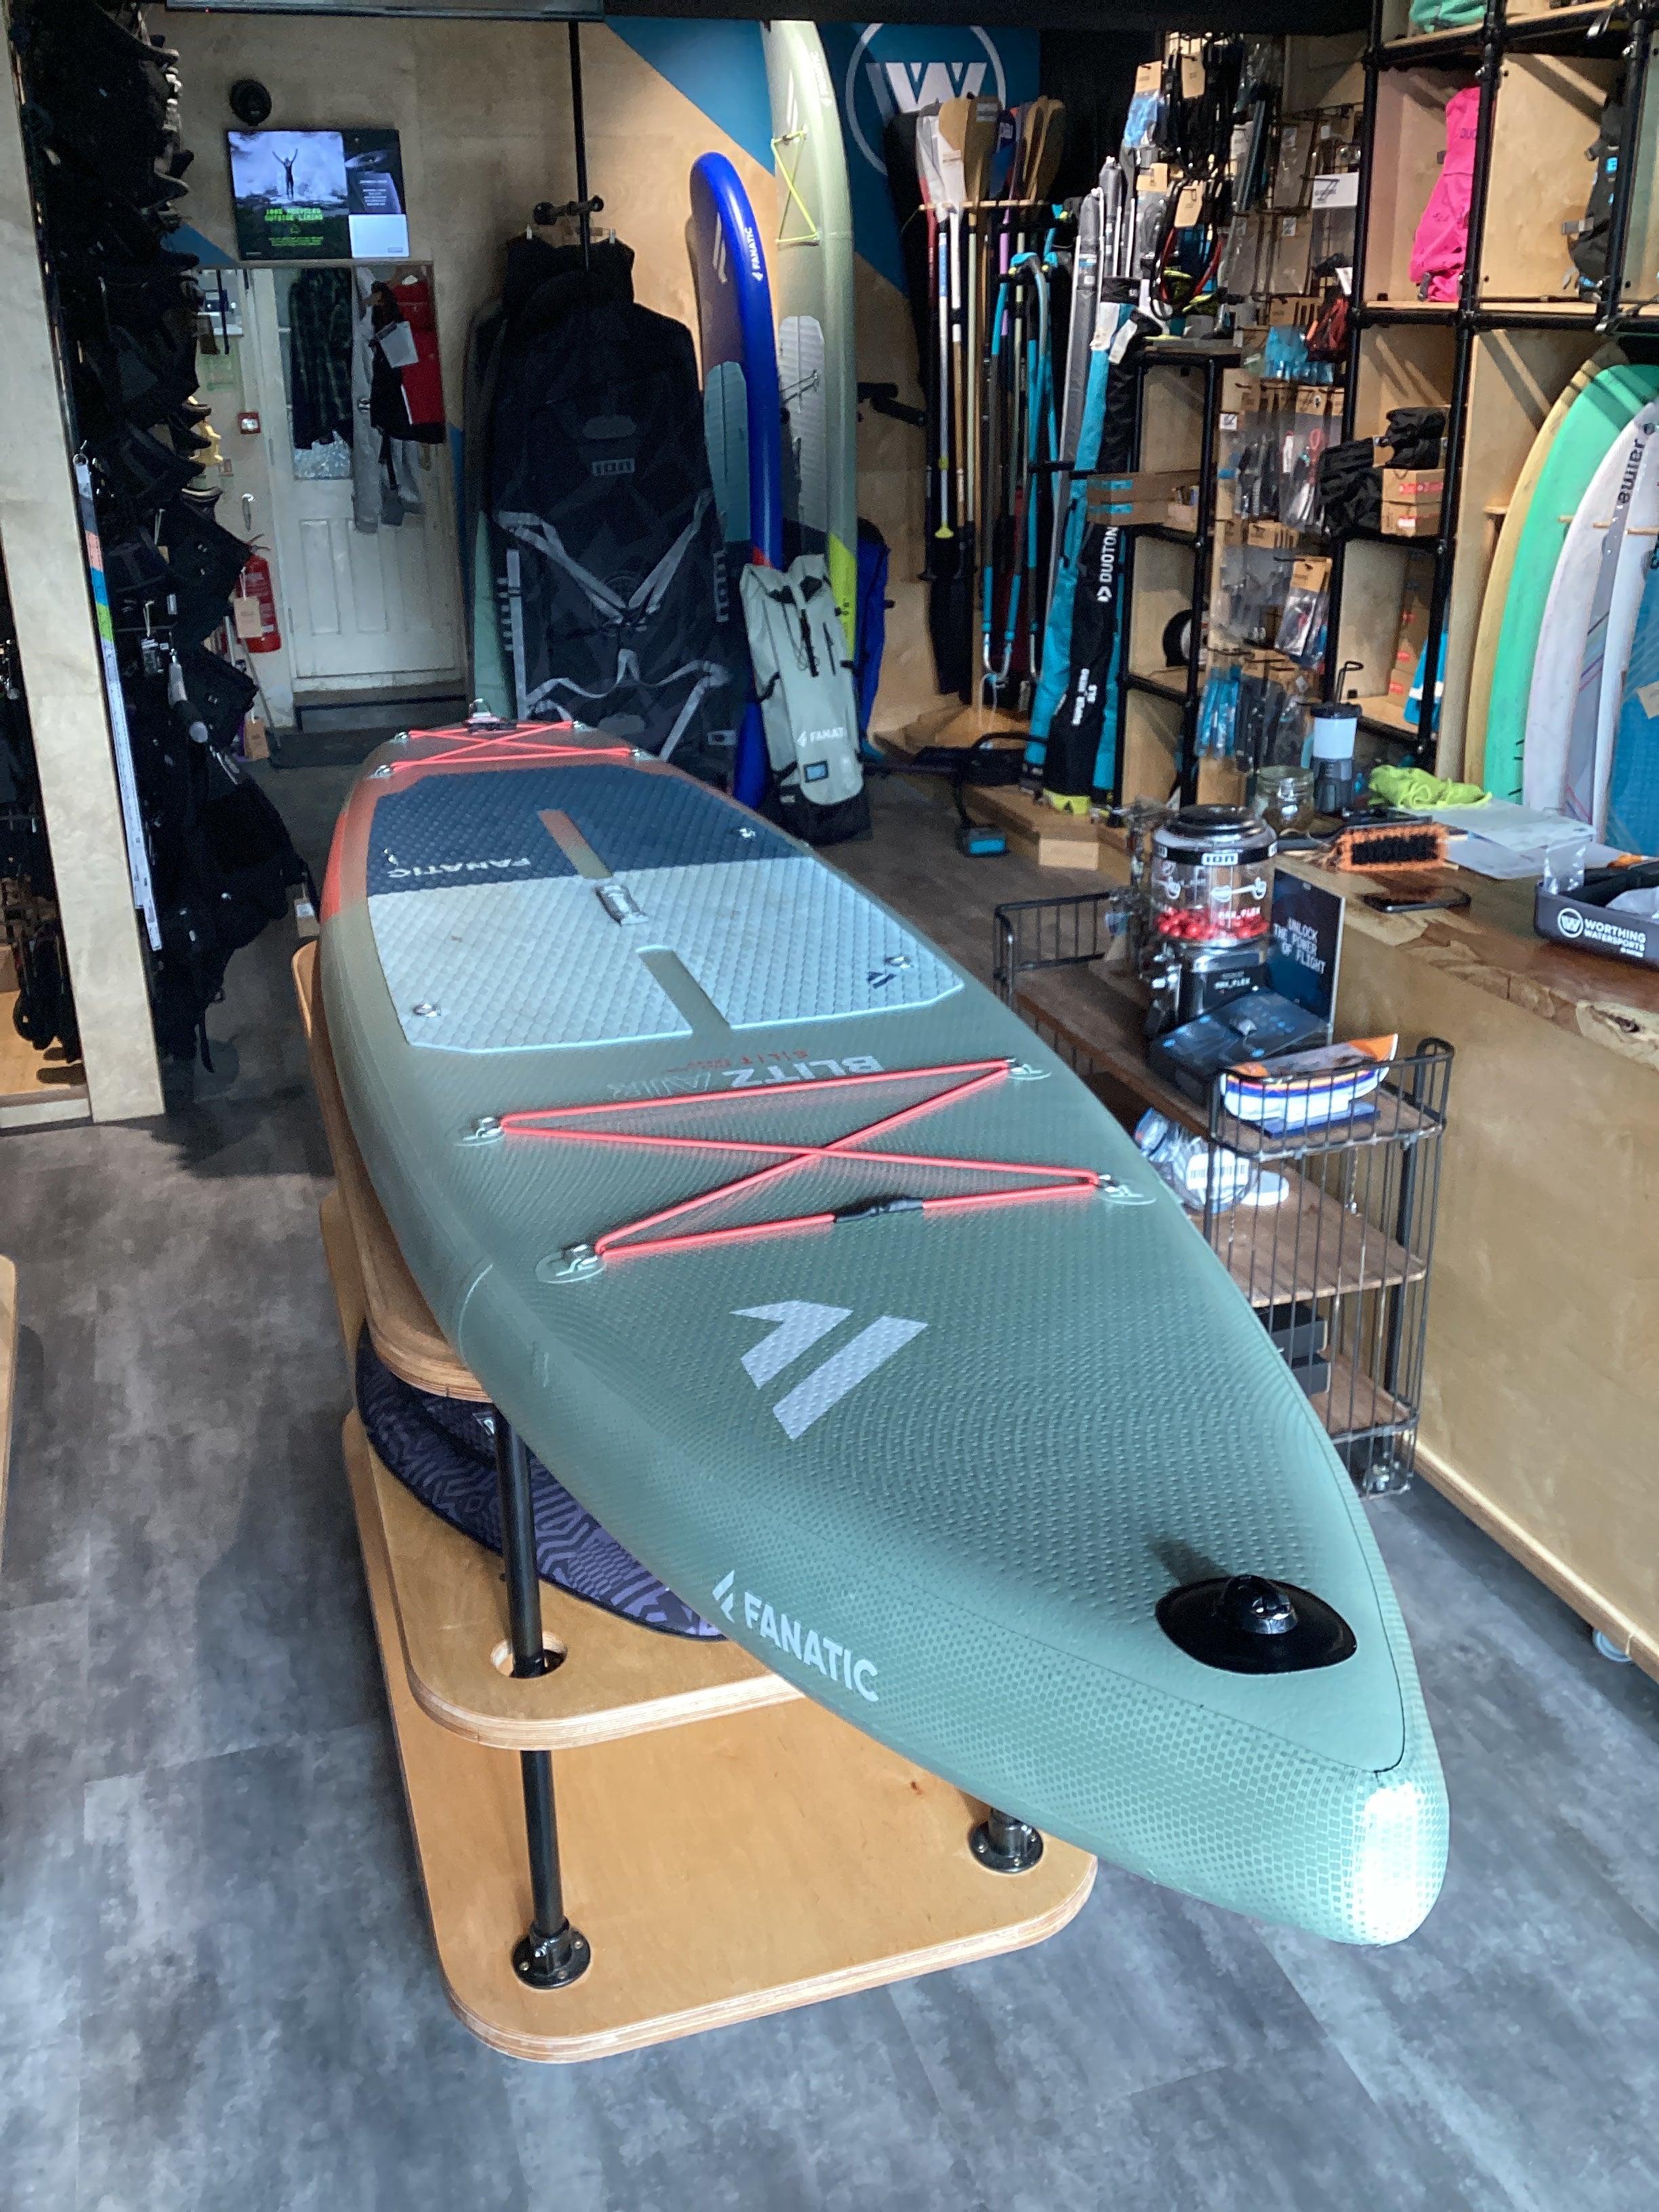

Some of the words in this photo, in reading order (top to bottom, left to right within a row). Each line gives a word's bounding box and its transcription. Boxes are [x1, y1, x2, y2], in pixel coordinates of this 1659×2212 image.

[745, 226, 760, 270] FANATIC
[810, 726, 847, 743] FANAT
[387, 857, 531, 878] FANATIC
[1273, 922, 1288, 941] THE
[1288, 917, 1318, 943] UNLOCK
[1584, 918, 1646, 944] WORTHING
[1296, 949, 1326, 975] FLIGHT
[722, 1055, 883, 1088] BLITZ
[745, 1591, 879, 1702] FANATIC
